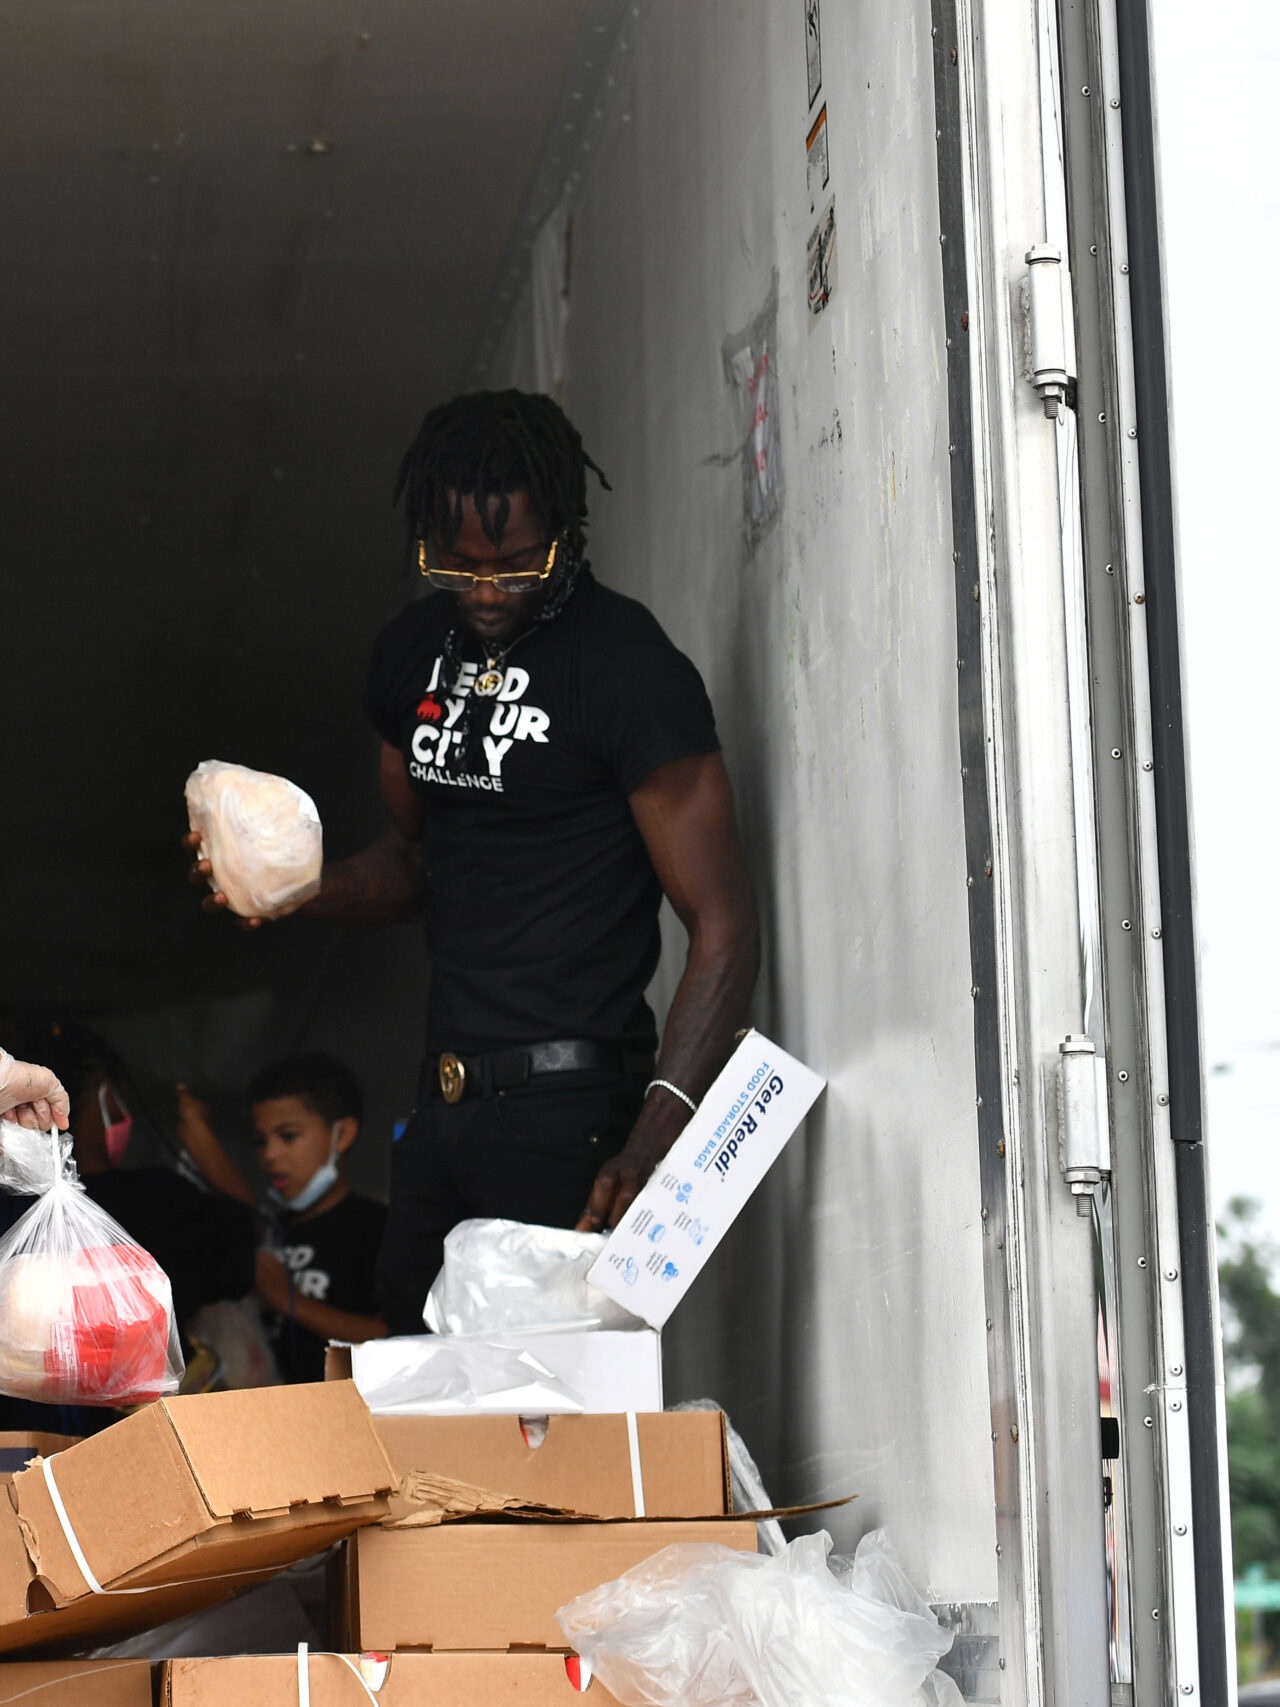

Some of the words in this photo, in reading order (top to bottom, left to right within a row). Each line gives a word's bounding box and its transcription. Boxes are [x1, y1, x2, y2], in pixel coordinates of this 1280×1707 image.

[443, 698, 550, 743] YUR
[409, 760, 504, 792] CHALLENGE
[746, 1061, 770, 1092] FOOD
[754, 1075, 784, 1115] Get
[713, 1091, 749, 1139] STORAGE
[694, 1139, 717, 1169] BAGS
[714, 1113, 758, 1176] Reddi
